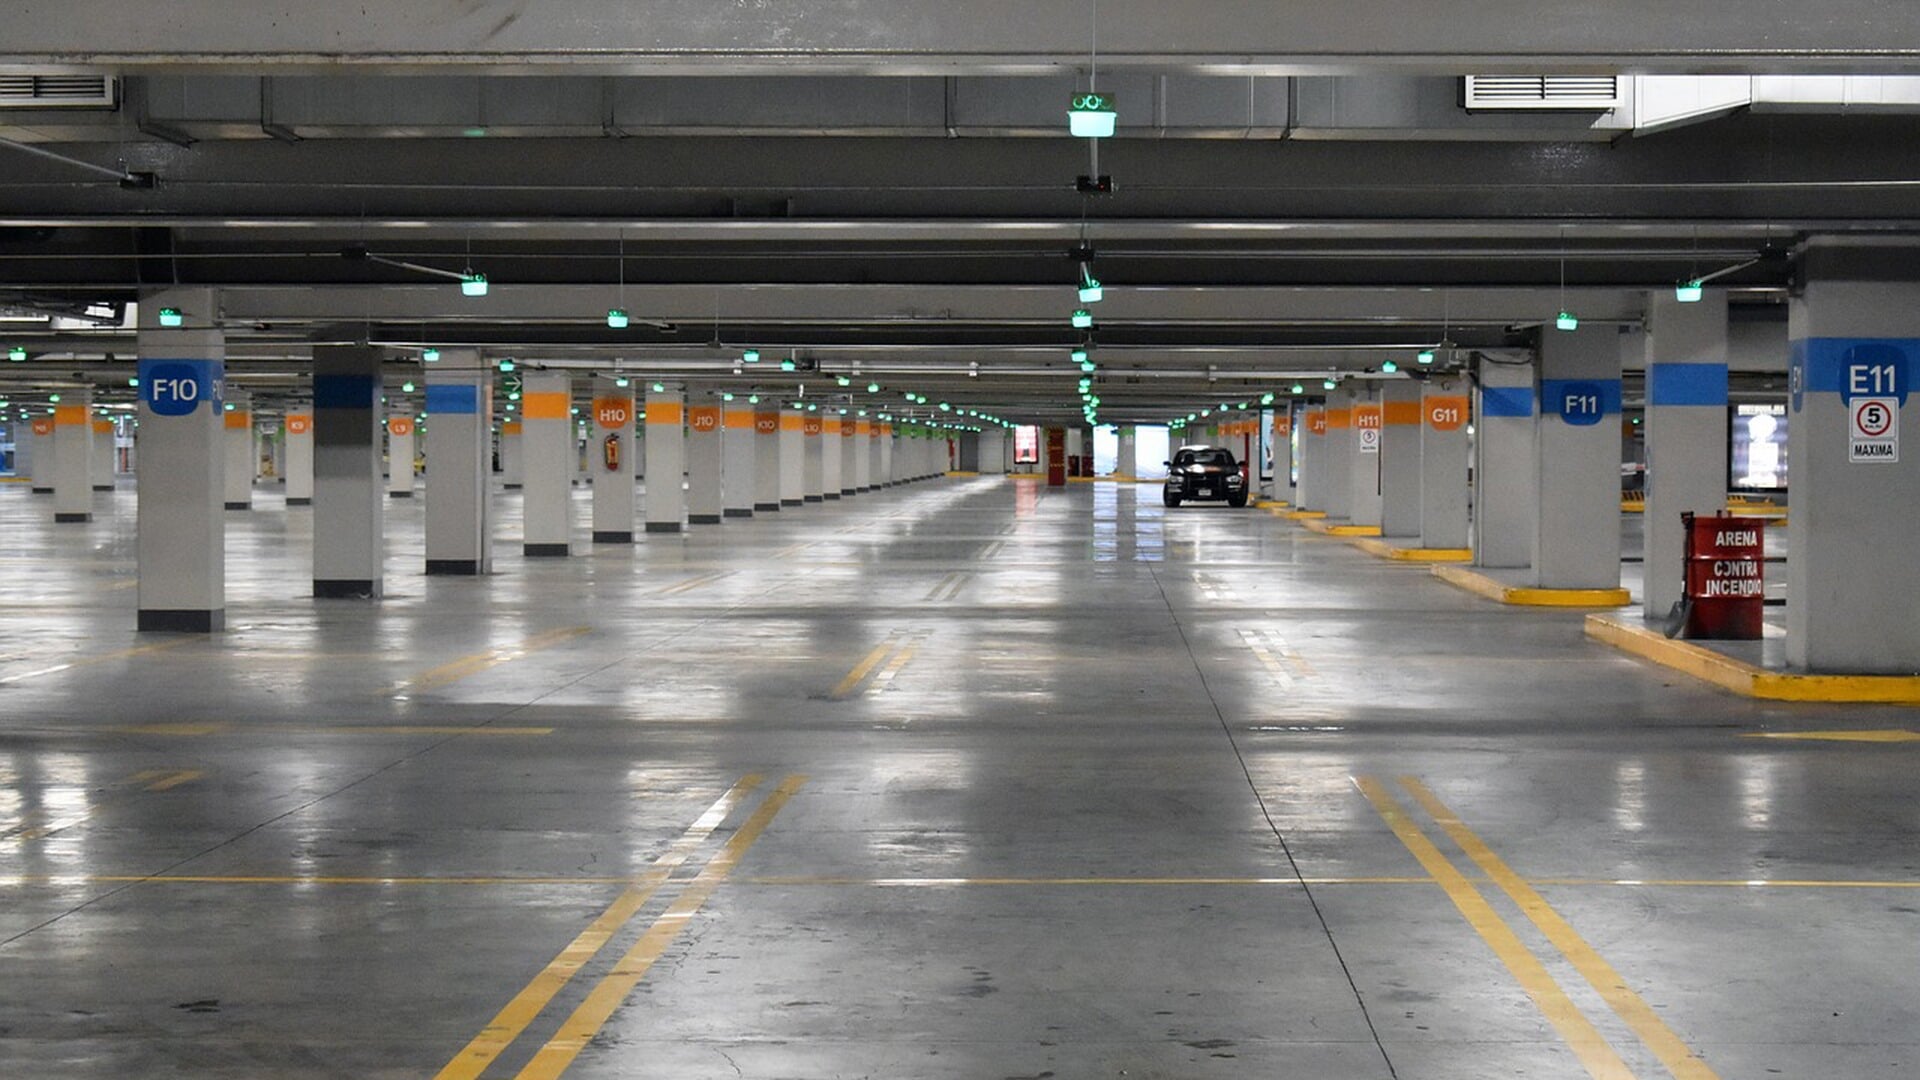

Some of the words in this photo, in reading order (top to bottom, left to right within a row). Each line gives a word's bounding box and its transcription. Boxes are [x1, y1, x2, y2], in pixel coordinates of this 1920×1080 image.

[1849, 365, 1895, 393] E11
[153, 379, 197, 401] F10
[1566, 395, 1597, 413] F11
[600, 409, 626, 422] H10
[695, 416, 713, 427] J10
[1358, 415, 1379, 427] H11
[1432, 408, 1458, 422] G11
[1868, 408, 1880, 424] 5
[1854, 445, 1893, 456] MAXIMA
[1715, 531, 1757, 546] ARENA
[1714, 561, 1758, 577] CONTRA
[1706, 580, 1762, 595] INCENDIO
